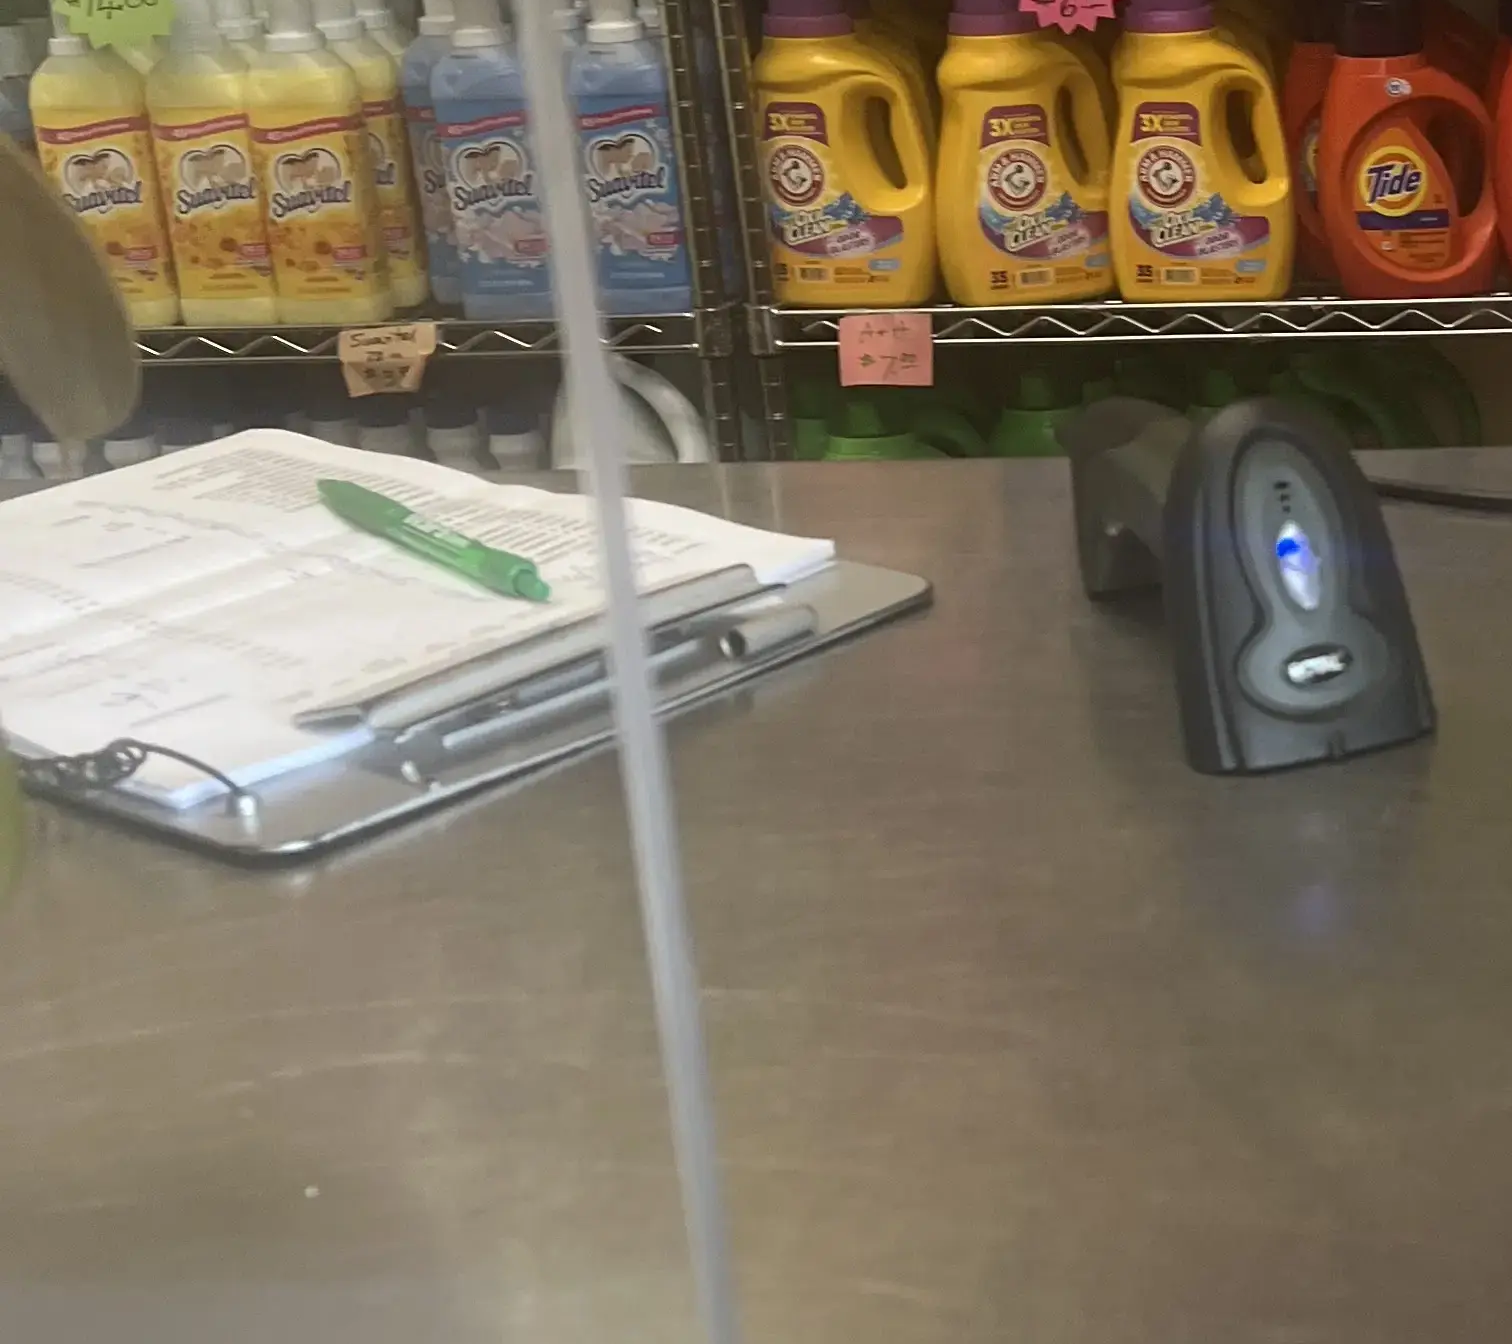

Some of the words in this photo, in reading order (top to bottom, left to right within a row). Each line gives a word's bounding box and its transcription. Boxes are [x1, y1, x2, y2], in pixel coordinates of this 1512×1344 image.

[176, 177, 257, 214] Suavitel
[271, 180, 353, 218] Suavitel
[454, 173, 533, 211] Suavitel
[588, 167, 666, 203] Suavitel
[1367, 163, 1423, 205] Tide
